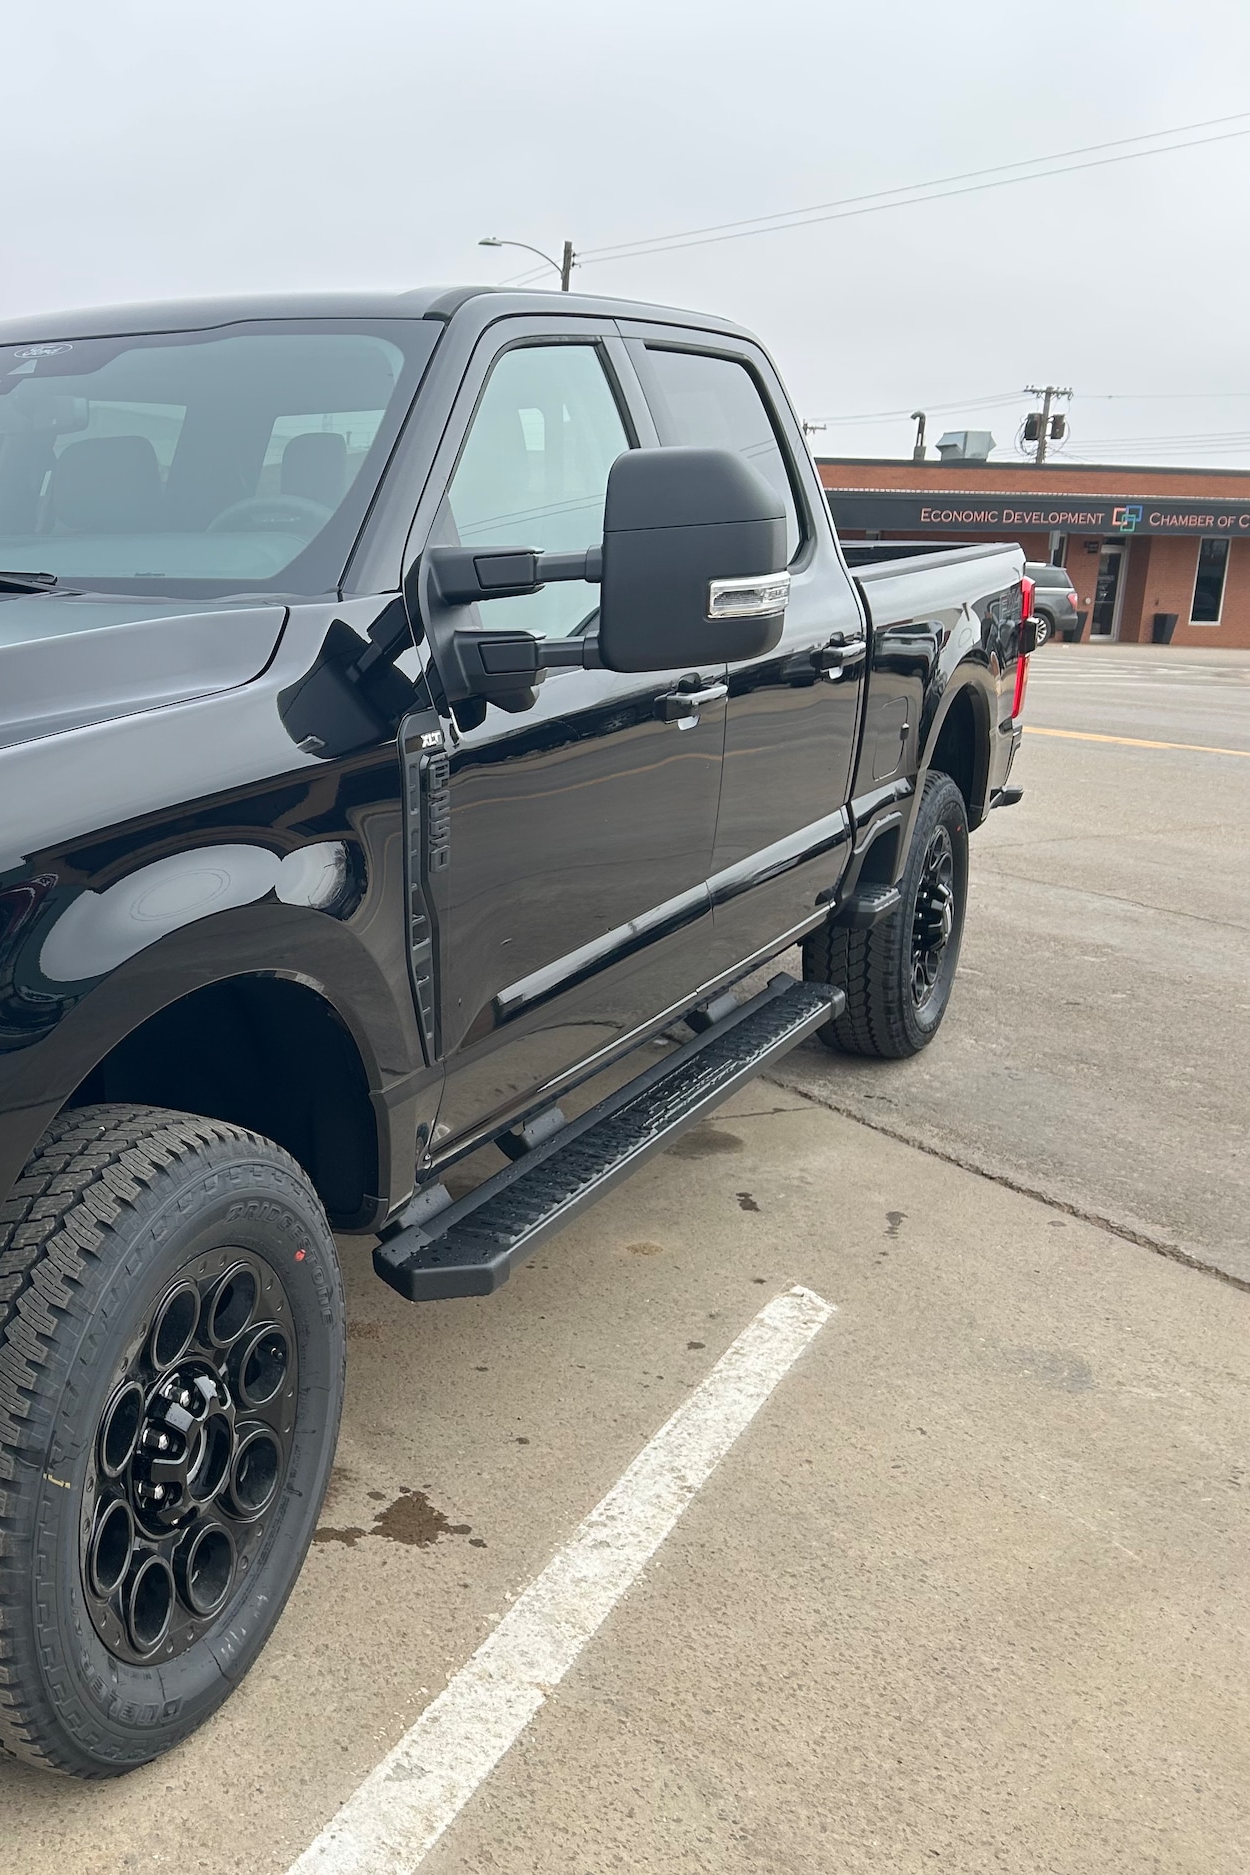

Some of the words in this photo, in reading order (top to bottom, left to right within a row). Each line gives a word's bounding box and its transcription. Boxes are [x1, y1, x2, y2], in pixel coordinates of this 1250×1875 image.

[920, 507, 998, 523] ECONOMIC
[1002, 509, 1105, 525] DEVELOPMENT
[1150, 512, 1214, 528] CHAMBER
[1217, 515, 1236, 528] OF
[420, 731, 442, 748] XLT
[225, 1201, 334, 1326] BRIDGESTONE
